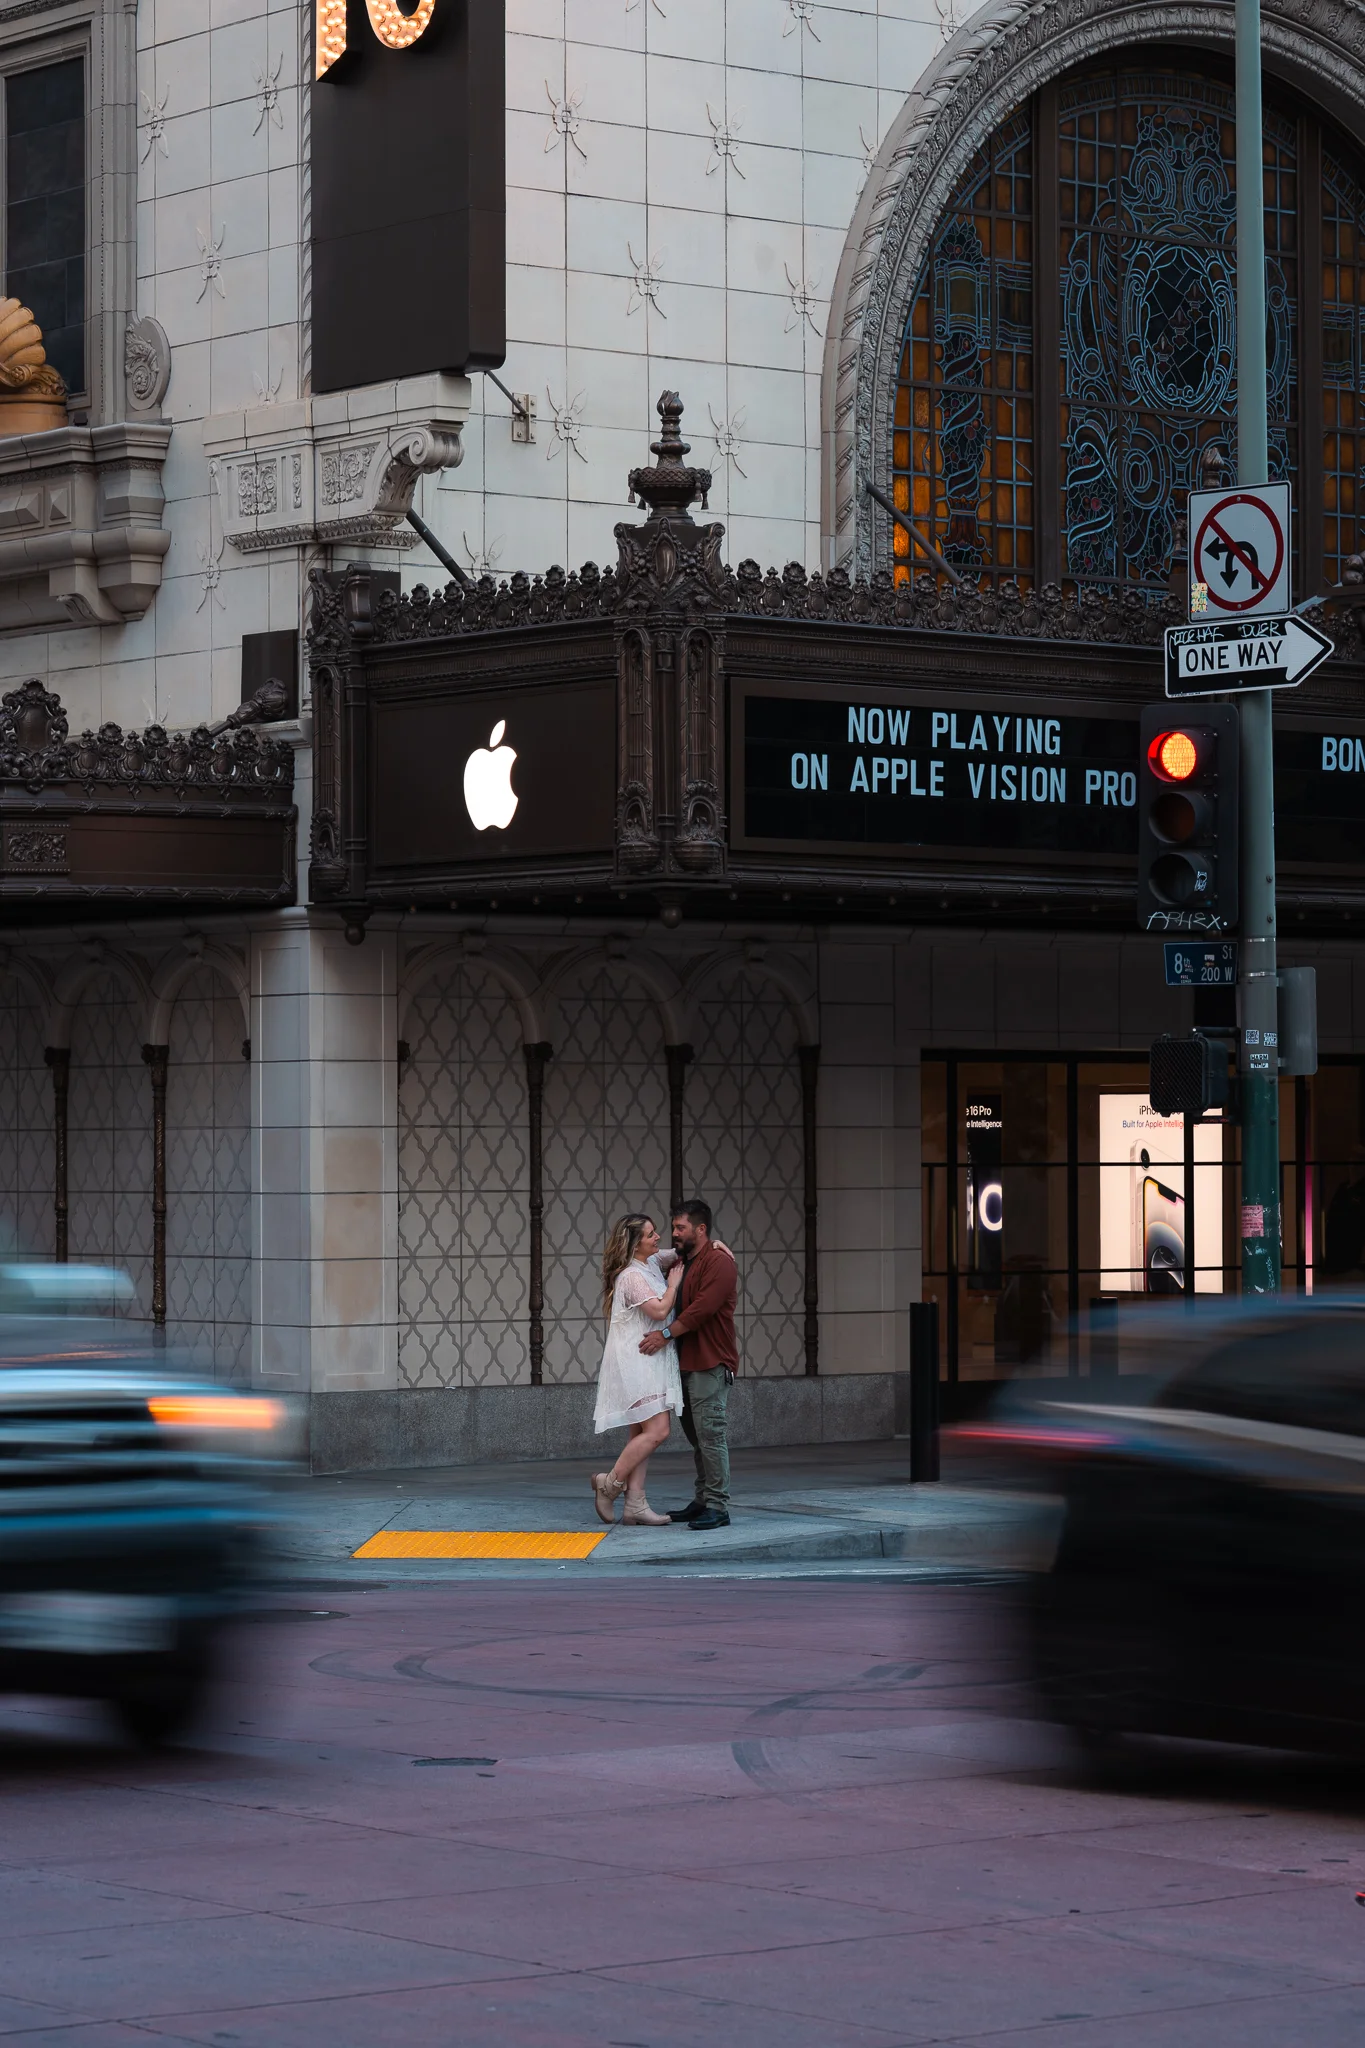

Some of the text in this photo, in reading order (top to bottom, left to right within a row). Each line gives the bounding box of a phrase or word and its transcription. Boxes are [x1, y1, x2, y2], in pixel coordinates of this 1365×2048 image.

[1186, 640, 1283, 672] ONE WAY
[848, 706, 1061, 755] NOW PLAYING
[791, 753, 1136, 807] ON APPLE VISION PRO
[1174, 952, 1190, 974] 8th
[1222, 945, 1232, 960] St
[1201, 967, 1220, 981] 200
[1224, 967, 1232, 981] W
[970, 1105, 978, 1116] 16
[979, 1105, 992, 1116] Pro
[1122, 1120, 1135, 1128] Built
[1136, 1120, 1144, 1128] for
[1145, 1120, 1162, 1129] Apple
